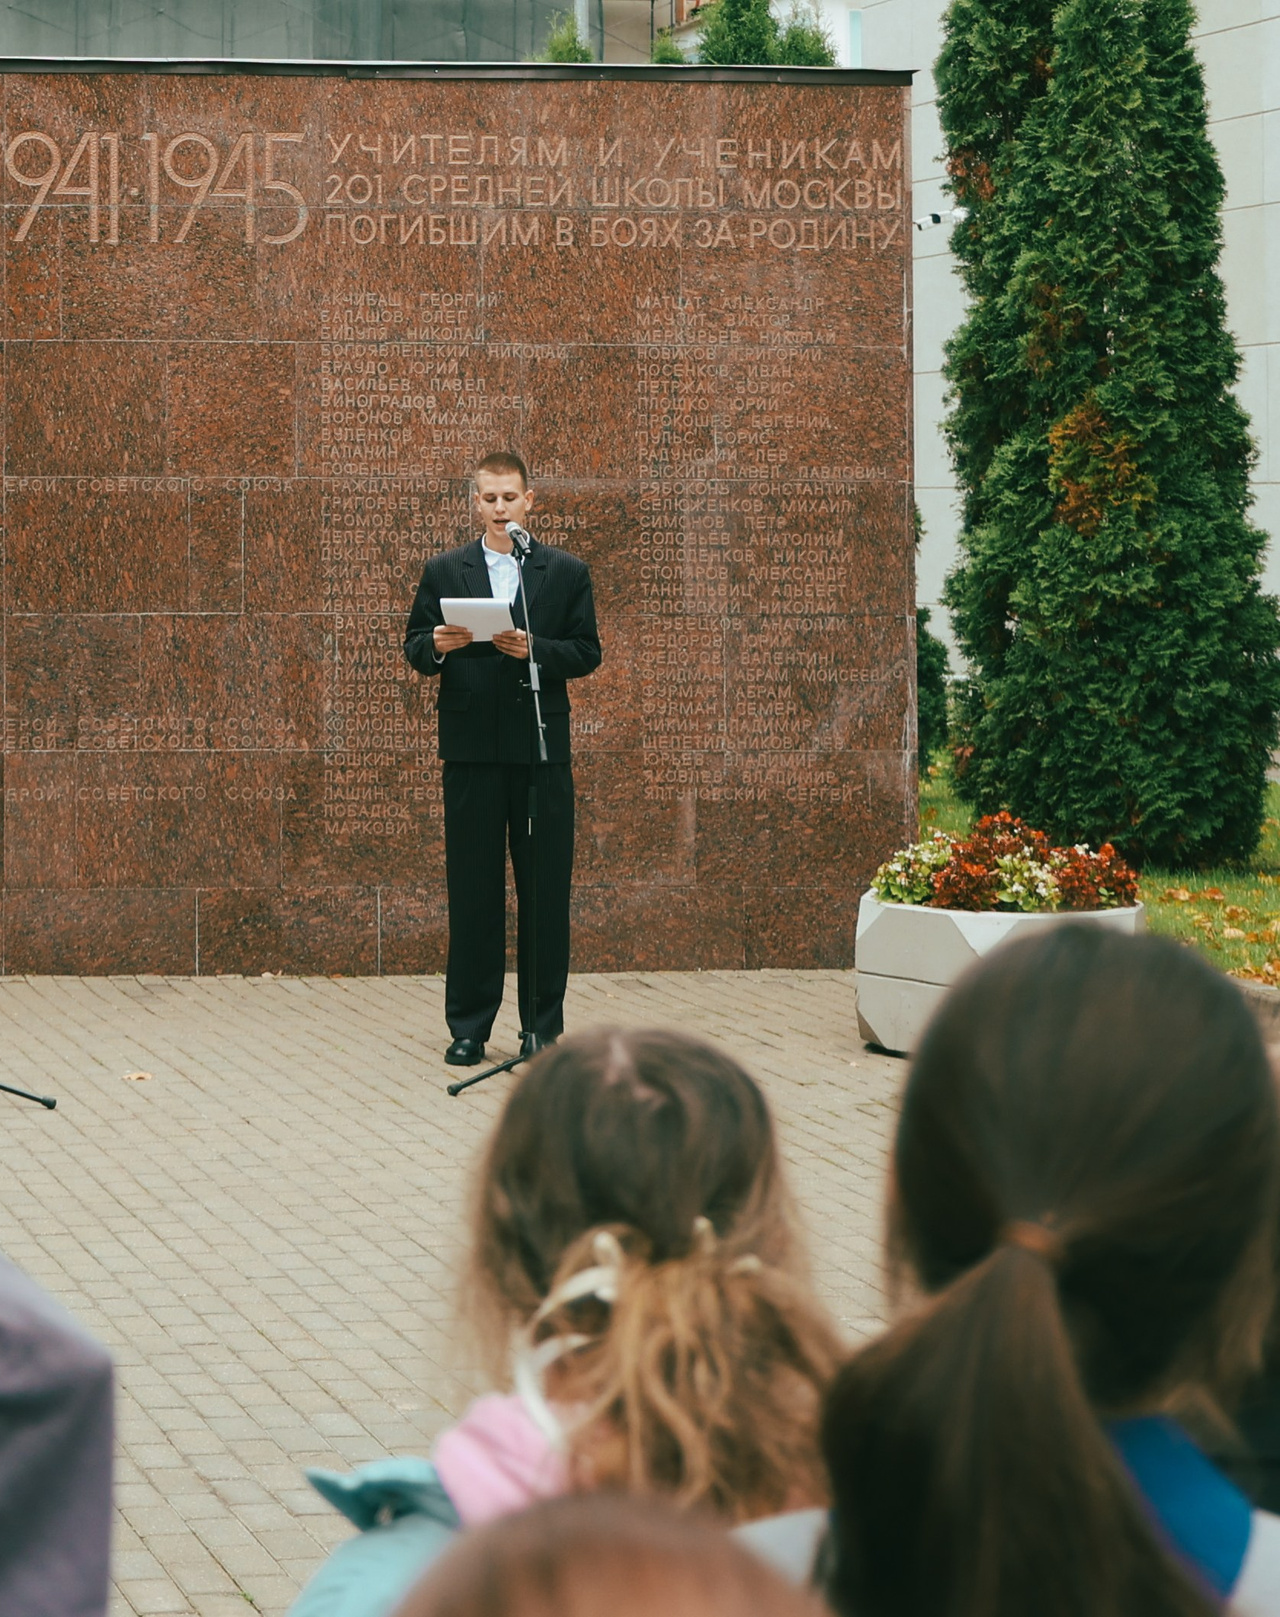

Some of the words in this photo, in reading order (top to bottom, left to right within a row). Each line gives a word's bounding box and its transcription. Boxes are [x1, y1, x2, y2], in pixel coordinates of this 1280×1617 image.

[326, 134, 568, 167] УЧИТЕЛЯМ
[599, 137, 623, 167] И
[654, 138, 902, 170] УЧЕНИКАМ
[326, 174, 383, 204] 201
[403, 173, 572, 207] СРЕДНЕЙ
[592, 176, 724, 208] ШКОЛЫ
[743, 178, 903, 210] МОСКВЫ
[325, 213, 539, 246] ПОГИБШИМ
[556, 216, 574, 246] В
[591, 216, 681, 248] БОЯХ
[694, 217, 737, 249] ЗА
[750, 218, 902, 251] РОДИНУ
[321, 292, 402, 307] АКЧИБАШ
[420, 291, 498, 307] ГЕОРГИЙ
[721, 297, 824, 310] АЛЕКСАНДР
[321, 309, 404, 323] БАЛАШОВ
[422, 310, 467, 323] ОЛЕГ
[407, 327, 484, 341] НИКОЛАЙ
[636, 330, 740, 344] МЕРКУРЬЕВ
[759, 331, 836, 344] НИКОЛАЙ
[321, 345, 470, 358] БОГОЯВЛЕНСКИЙ
[489, 345, 568, 359] НИКОЛАЙ
[637, 347, 717, 361] НОВИКОВ
[735, 347, 822, 362] ГРИГОРИЙ
[321, 361, 389, 375] БРАУДО
[410, 361, 459, 374] ЮРИЙ
[638, 364, 730, 377] НОСЕНКОВ
[748, 364, 792, 378] ИВАН
[322, 378, 411, 391] ВАСИЛЬЕВ
[430, 378, 486, 392] ПАВЕЛ
[638, 381, 717, 395] ПЕТРЖАК
[736, 381, 794, 395] БОРИС
[321, 395, 437, 409] ВИНОГРАДОВ
[638, 398, 710, 411] ПЛОШКО
[730, 398, 780, 411] ЮРИЙ
[322, 411, 403, 425] ВОРОНОВ
[422, 411, 493, 426] МИХАИЛ
[638, 414, 732, 427] ПРОКОШЕВ
[433, 429, 499, 443] ВИКТОР
[638, 431, 696, 445] ПУЛЬС
[715, 431, 771, 445] БОРИС
[321, 445, 398, 459] ГАЛАНИН
[639, 448, 738, 462] РАДУНСКИЙ
[756, 448, 788, 462] ЛЕВ
[322, 462, 445, 476] ГОФЕНШЕФЕР
[639, 465, 708, 478] РЫСКИН
[725, 466, 780, 479] ПАВЕЛ
[798, 466, 887, 480] ПАВЛОВИЧ
[76, 479, 205, 492] СОВЕТСКОГО
[225, 479, 295, 492] СОЮЗА
[322, 479, 450, 494] ГРАЖДАНИНОВ
[639, 482, 730, 495] РЯБОКОНЬ
[748, 482, 858, 496] КОНСТАНТИН
[322, 496, 421, 510] ГРИГОРЬЕВ
[781, 498, 852, 513] МИХАИЛ
[322, 513, 393, 527] ГРОМОВ
[414, 513, 471, 527] БОРИС
[639, 515, 726, 529] СИМОНОВ
[321, 530, 455, 544] ДЕЛЕКТОРСКИЙ
[748, 531, 838, 546] АНАТОЛИЙ
[774, 549, 851, 563] НИКОЛАЙ
[640, 565, 729, 579] СТОЛЯРОВ
[748, 567, 847, 581] АЛЕКСАНДР
[771, 583, 847, 598] АЛЬБЕРТ
[322, 599, 402, 612] ИВАНОВА
[759, 600, 837, 615] НИКОЛАЙ
[641, 617, 741, 631] ТРУБЕЦКОВ
[641, 634, 722, 648] ФЕДОРОВ
[323, 649, 407, 663] КАМИНСК
[641, 651, 722, 665] ФЕДОТОВ
[323, 666, 420, 681] КЛИМКОВИ
[736, 668, 789, 682] АБРАМ
[324, 684, 402, 697] КОБЯКОВ
[642, 685, 717, 698] ФУРМАН
[736, 685, 792, 699] АБРАМ
[642, 701, 717, 715] ФУРМАН
[324, 718, 439, 732] КОСМОДЕМЬЯ
[642, 718, 700, 732] ЧИКИН
[718, 718, 812, 733] ВЛАДИМИР
[77, 735, 207, 749] СОВЕТСКОГО
[324, 735, 439, 749] КОСМОДЕМЬЯ
[812, 736, 845, 750] ЛЕВ
[324, 752, 396, 766] КОШКИН
[643, 752, 705, 766] ЮРЬЕВ
[723, 753, 818, 768] ВЛАДИМИР
[324, 769, 380, 783] ЛАРИН
[399, 769, 443, 783] ИГОР
[643, 769, 722, 783] ЯКОВЛЕВ
[742, 770, 835, 784] ВЛАДИМИР
[78, 786, 207, 800] СОВЕТСКОГО
[225, 786, 297, 800] СОЮЗА
[324, 786, 384, 800] ЛАШИН
[786, 784, 854, 801] СЕРГЕЙ
[324, 803, 410, 818] ЛОБАДЮК
[324, 820, 420, 834] МАРКОВИЧ
